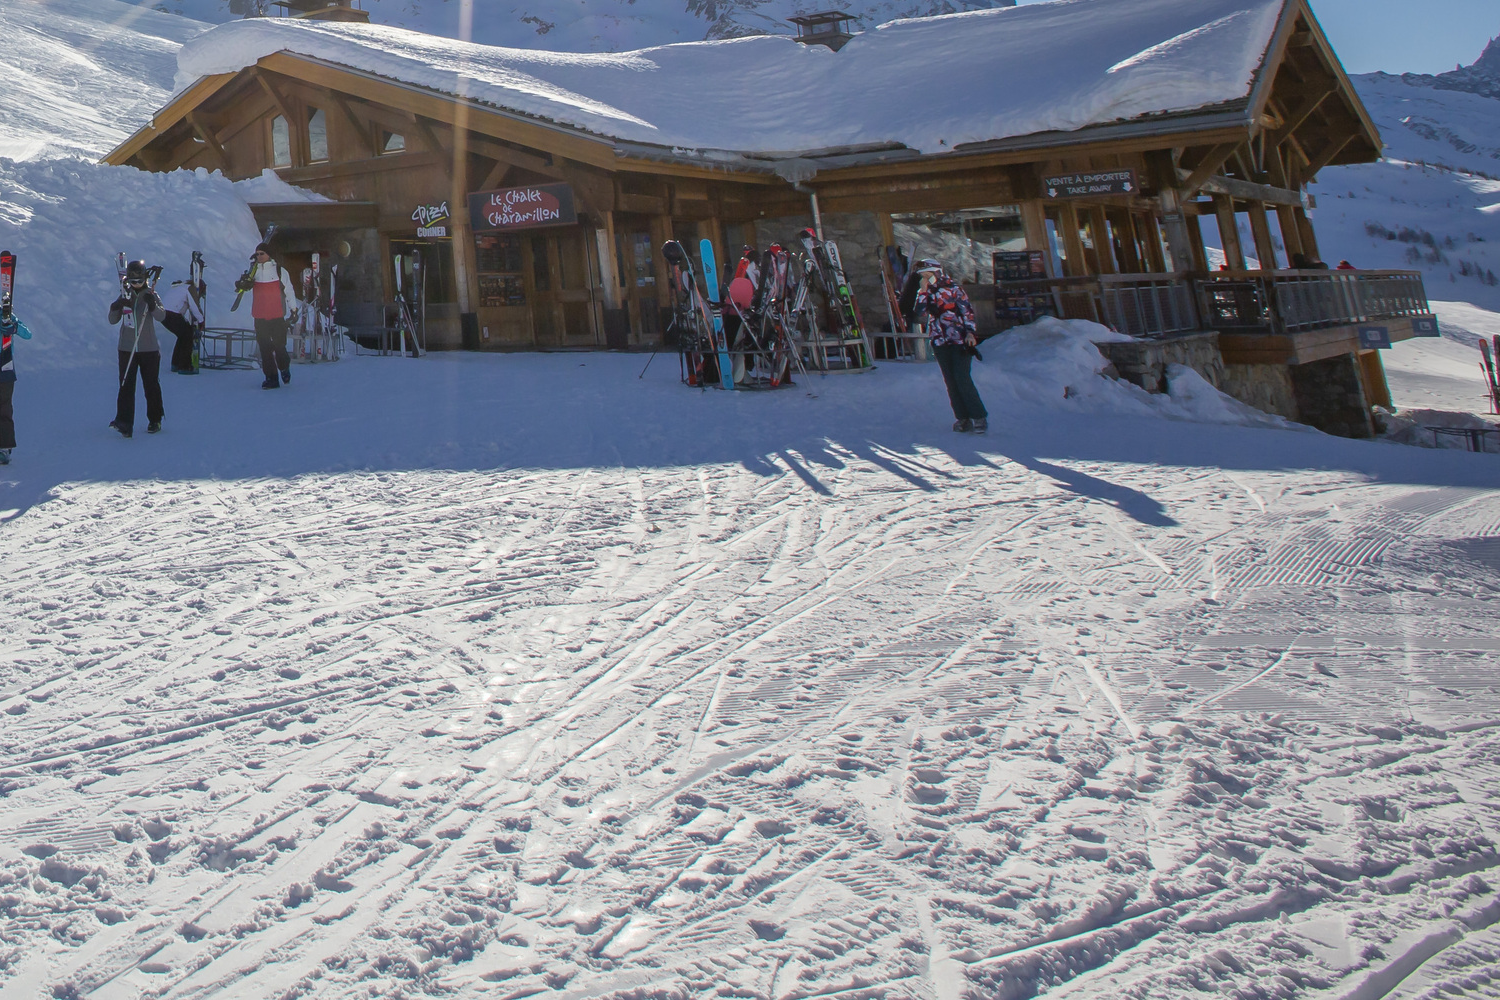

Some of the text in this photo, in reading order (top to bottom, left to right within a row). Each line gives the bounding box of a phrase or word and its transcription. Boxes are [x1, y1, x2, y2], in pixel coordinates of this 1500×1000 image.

[1046, 177, 1074, 186] VENTE
[1084, 172, 1131, 183] EMPORTER
[1067, 184, 1112, 194] TAKE AWAY
[417, 227, 446, 237] CORNER
